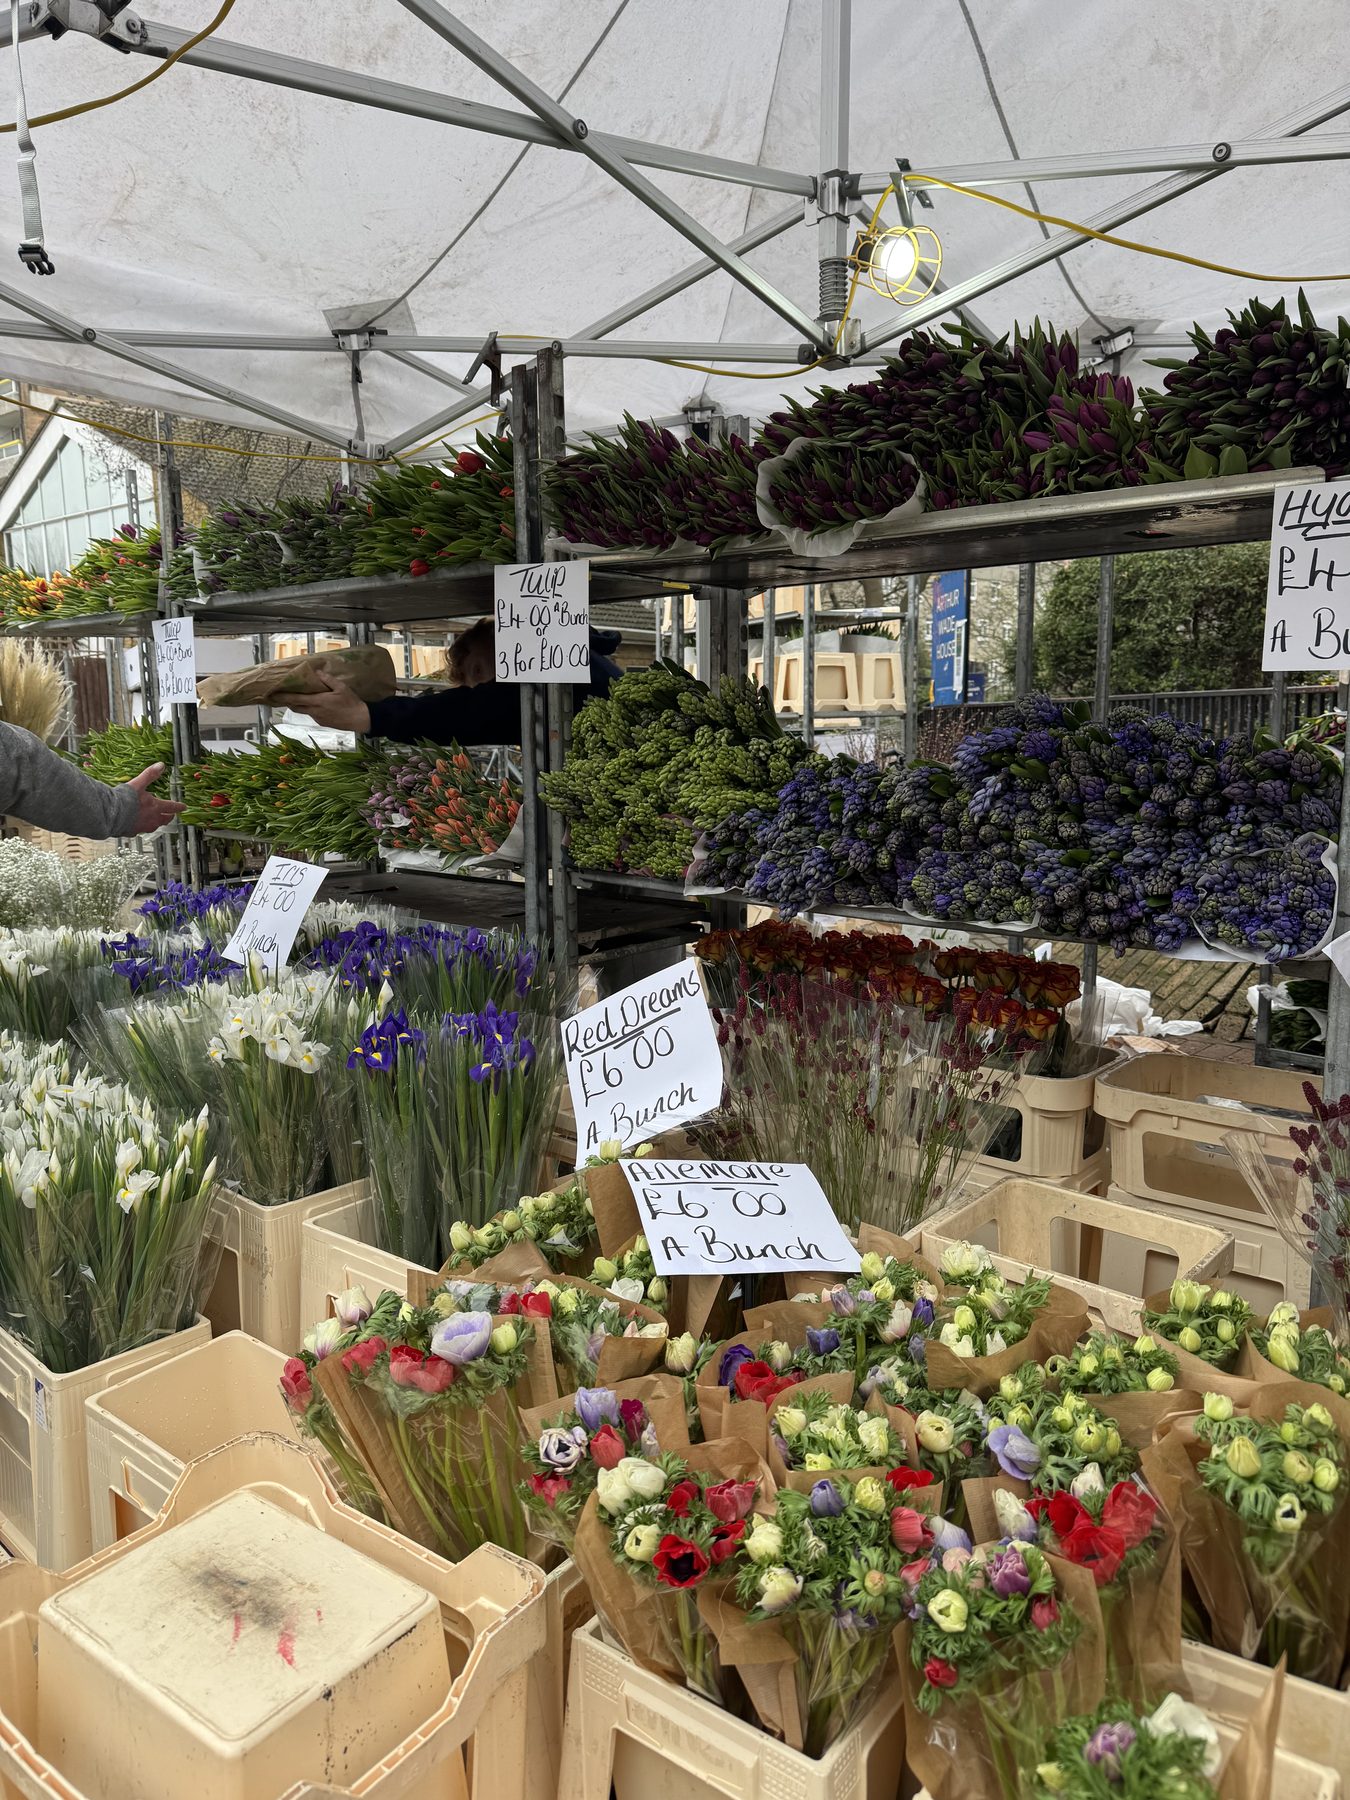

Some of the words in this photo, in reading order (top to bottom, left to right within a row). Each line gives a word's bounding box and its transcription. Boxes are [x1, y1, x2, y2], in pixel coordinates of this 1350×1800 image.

[558, 600, 589, 627] Bunch
[936, 588, 960, 613] ARTHUR
[536, 625, 548, 637] or
[938, 614, 956, 636] WADE
[1270, 619, 1293, 653] A
[497, 651, 510, 679] 3
[514, 642, 535, 676] for
[936, 639, 956, 660] HOUSE
[160, 679, 166, 697] 3
[233, 923, 247, 945] A
[239, 919, 278, 954] Bunch
[565, 1013, 618, 1063] Red
[620, 969, 701, 1037] Dreams
[586, 1120, 602, 1150] A
[610, 1082, 699, 1143] Bunch
[660, 1235, 690, 1261] A
[693, 1224, 847, 1264] Bunch
